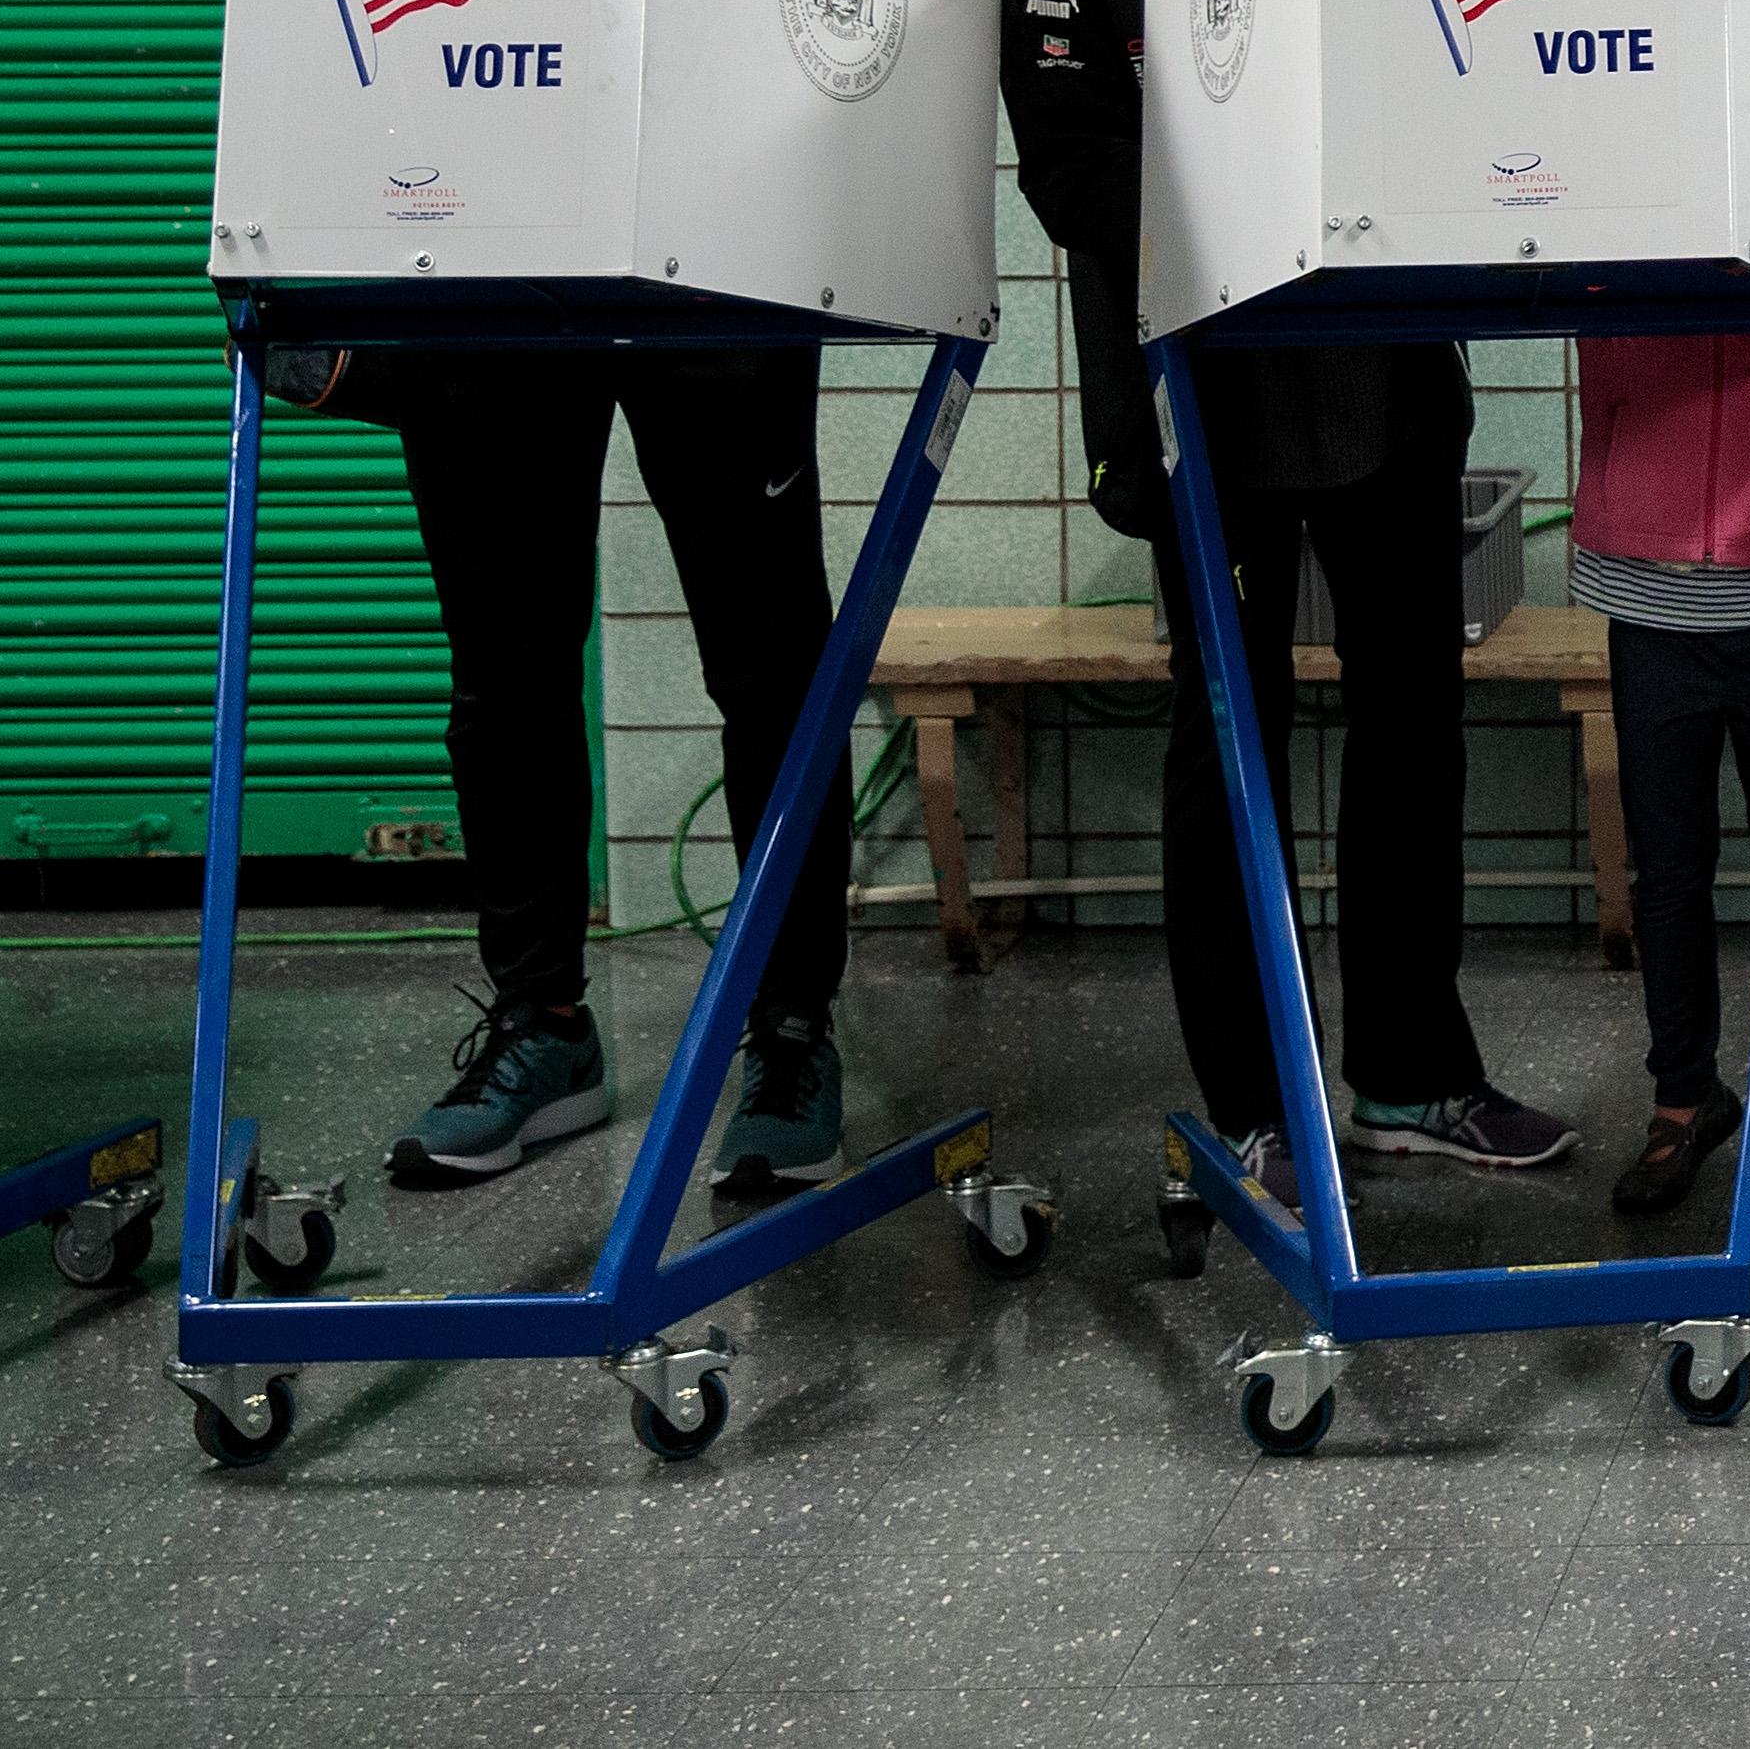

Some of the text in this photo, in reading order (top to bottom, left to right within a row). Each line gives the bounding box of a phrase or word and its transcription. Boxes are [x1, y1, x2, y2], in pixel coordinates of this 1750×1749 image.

[441, 43, 563, 89] VOTE
[801, 41, 832, 81] CITY
[832, 70, 851, 91] OF
[854, 56, 882, 90] NEW
[1533, 28, 1654, 75] VOTE
[382, 188, 459, 198] SMARTPOLL
[1486, 172, 1561, 184] SMARTPOLL
